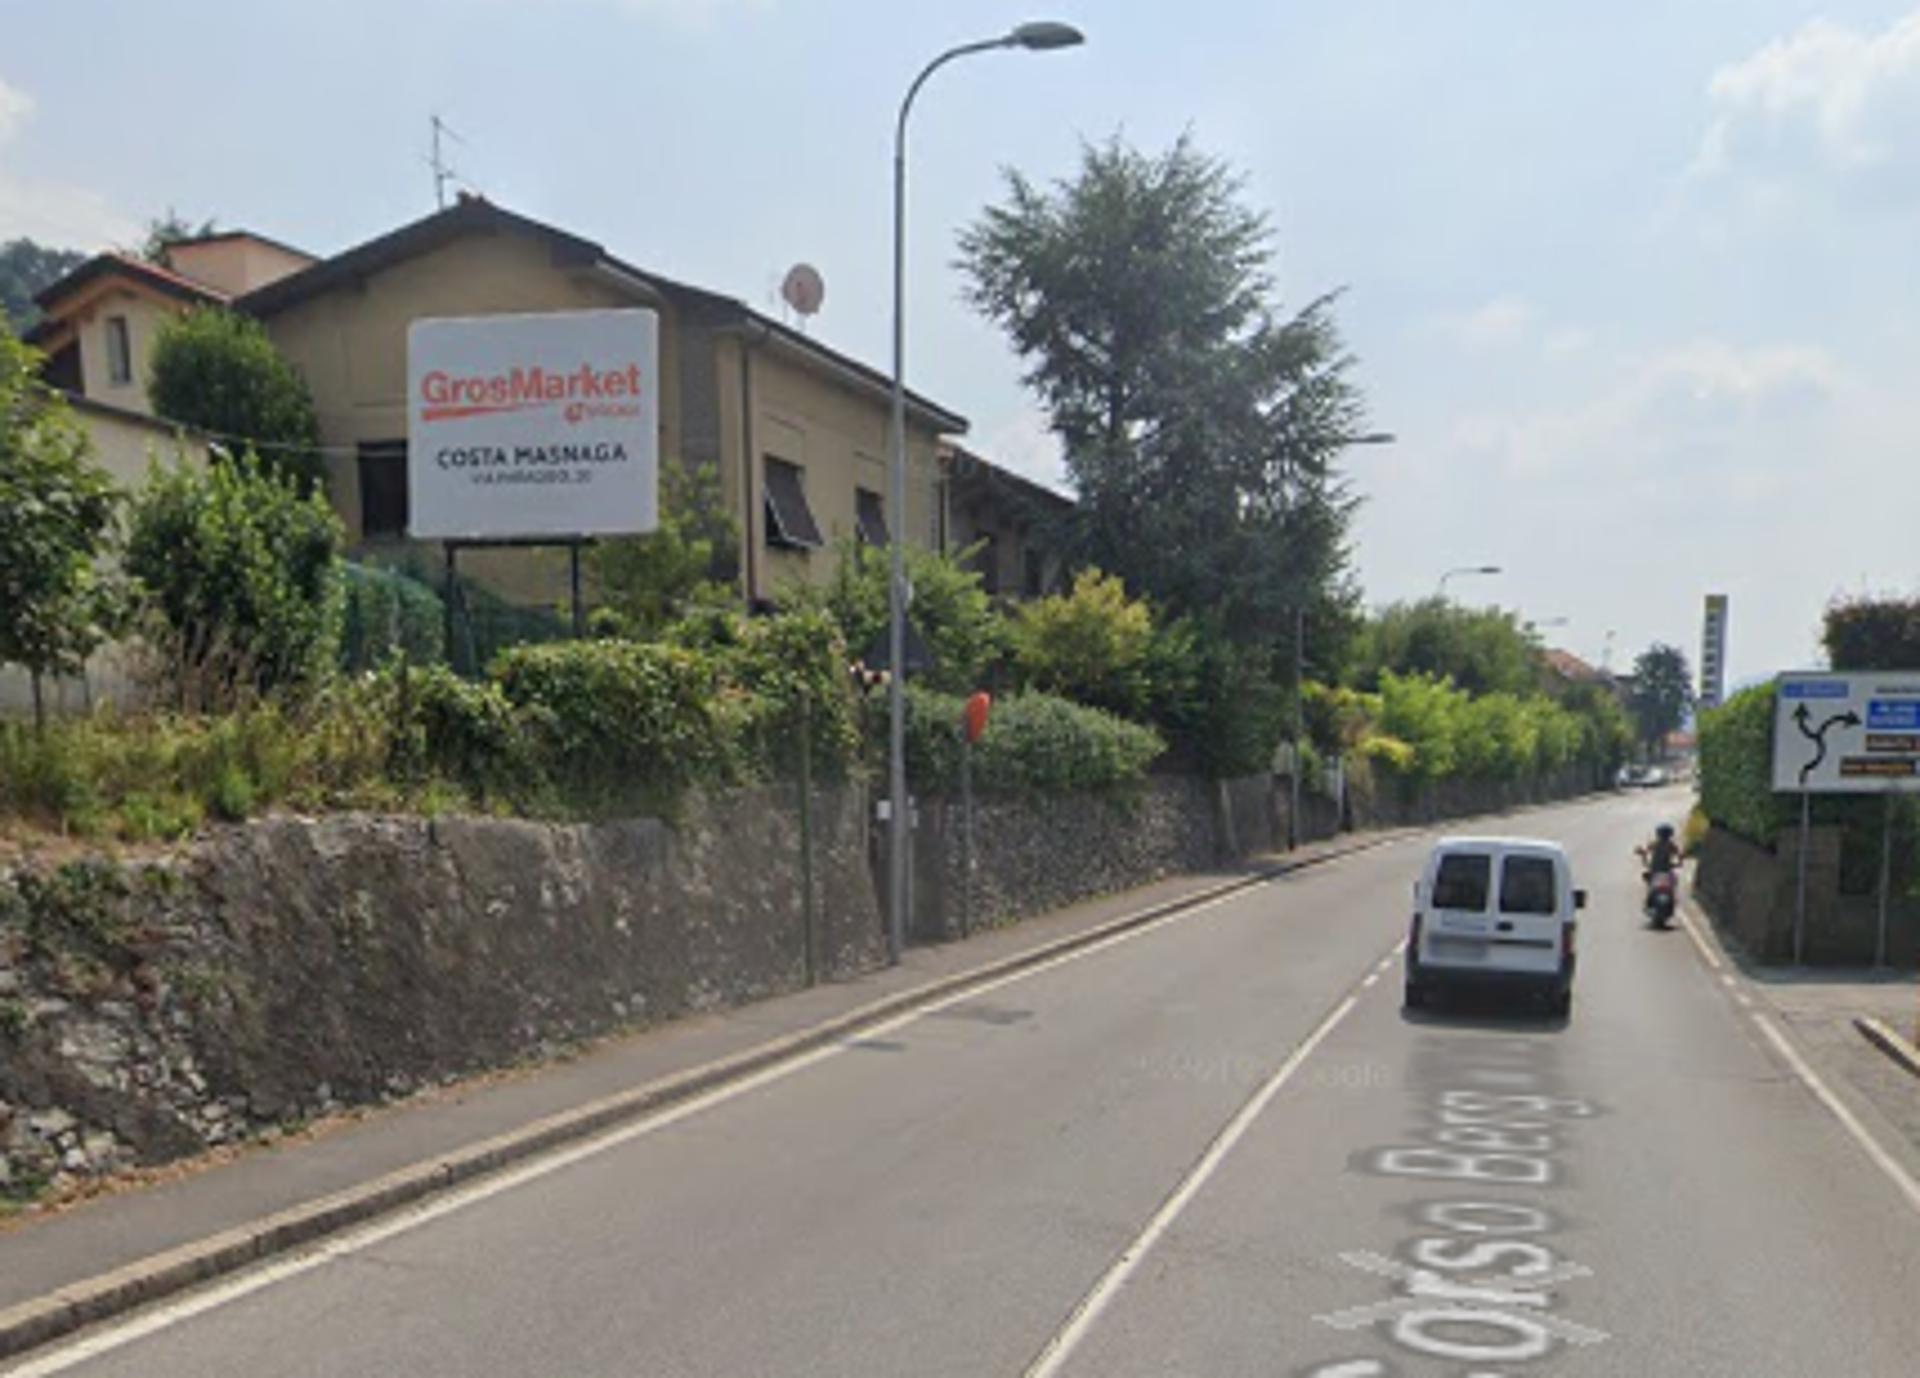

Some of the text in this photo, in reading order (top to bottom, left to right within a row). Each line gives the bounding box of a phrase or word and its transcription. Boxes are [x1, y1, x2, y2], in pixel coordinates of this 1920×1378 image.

[421, 362, 641, 404] GrosMarket
[436, 443, 628, 469] COSTA MASNAGA
